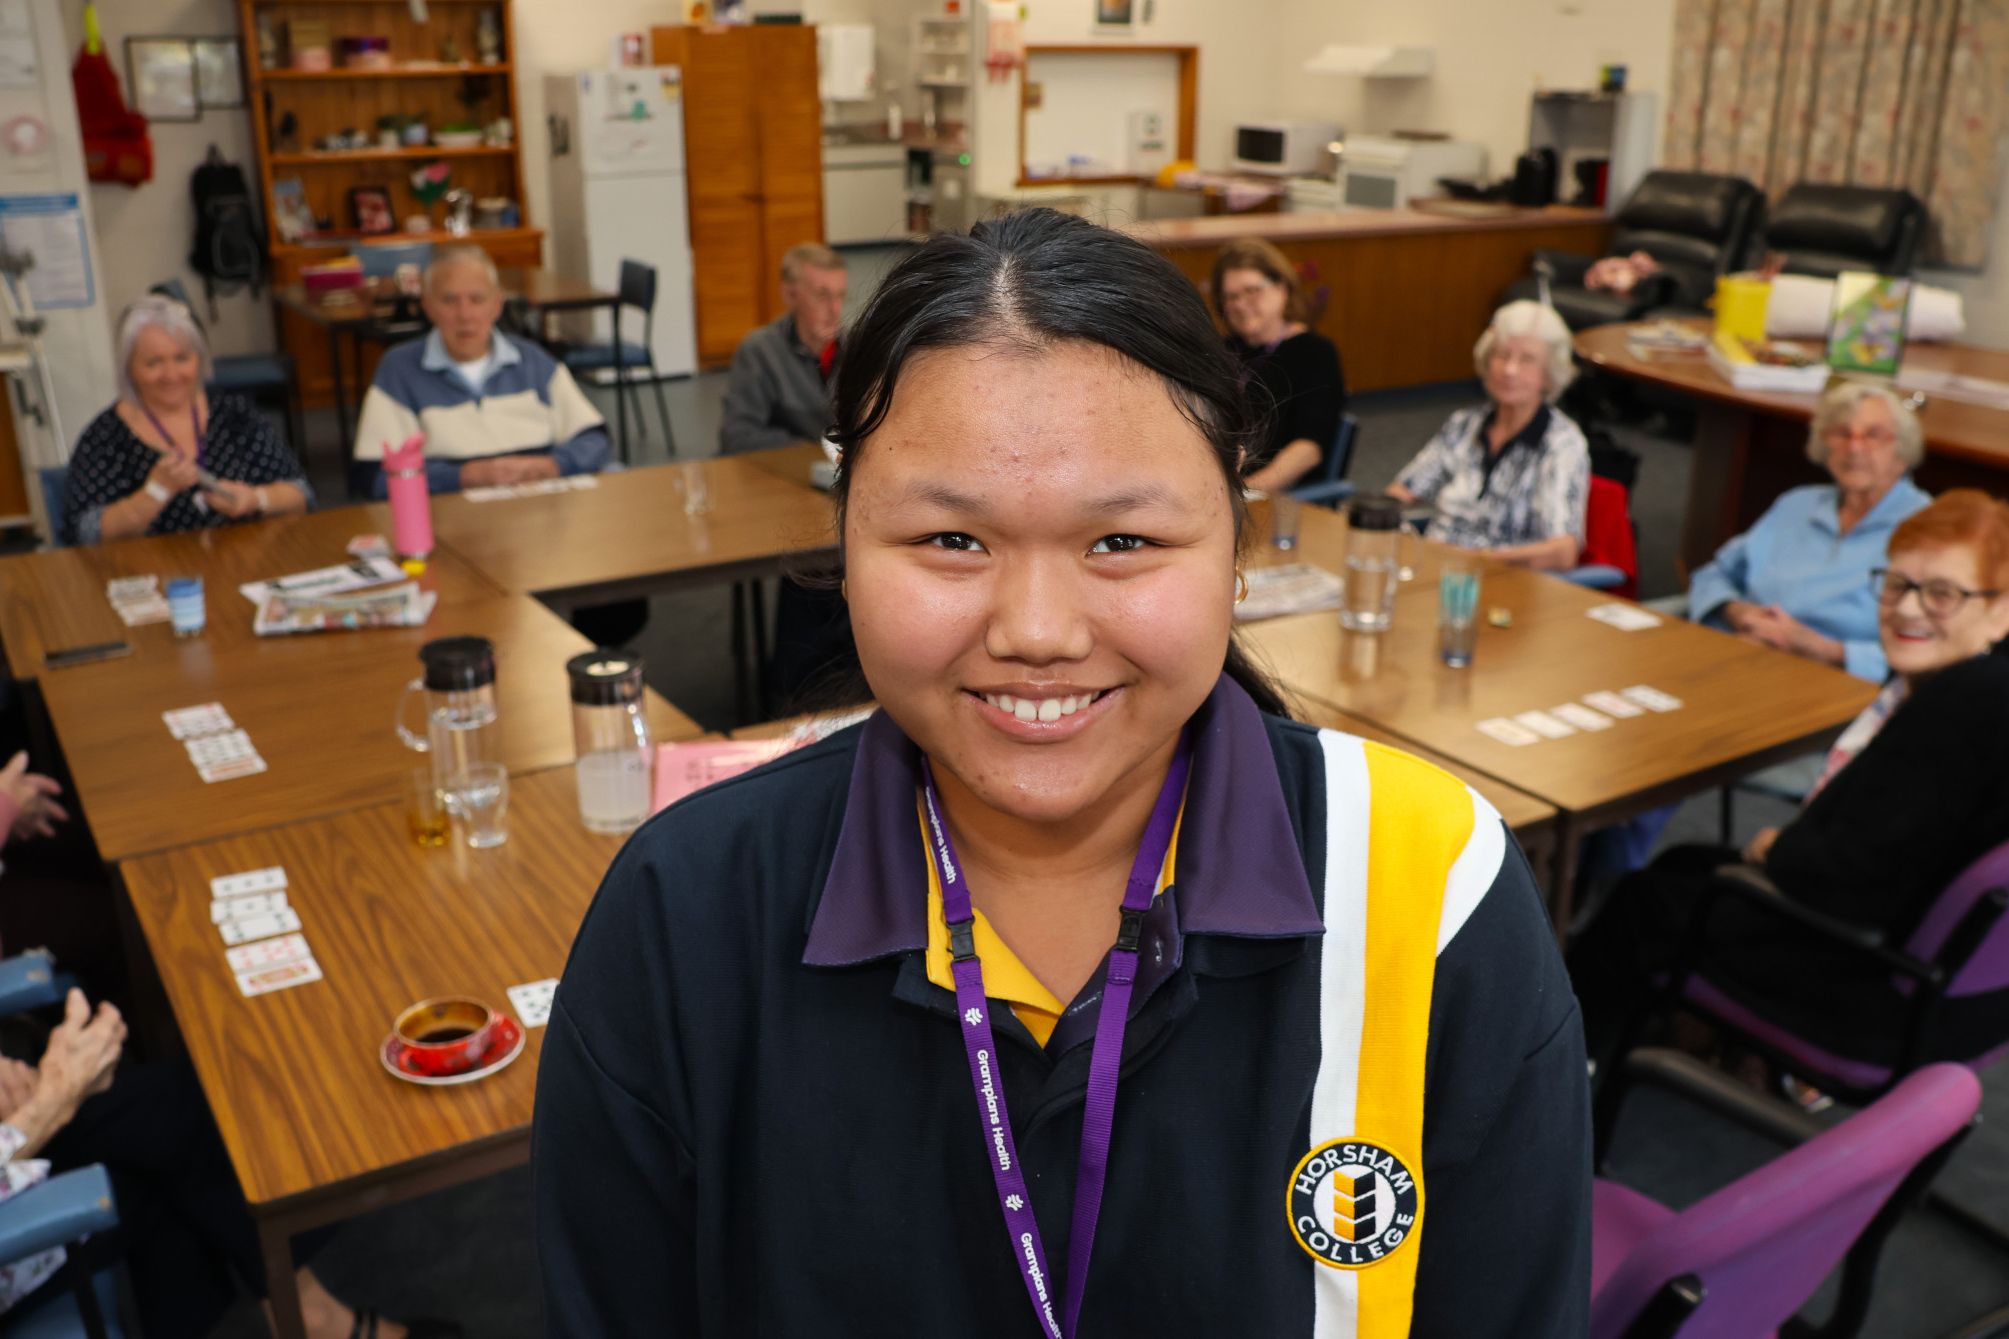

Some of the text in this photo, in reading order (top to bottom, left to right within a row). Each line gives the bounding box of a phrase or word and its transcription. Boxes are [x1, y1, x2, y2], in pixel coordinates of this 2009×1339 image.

[940, 845, 956, 884] Health
[977, 1049, 1011, 1171] Grampians Health
[1295, 1144, 1414, 1195] HORSHAM
[1297, 1213, 1414, 1263] COLLEGE
[1021, 1232, 1048, 1302] Grampians
